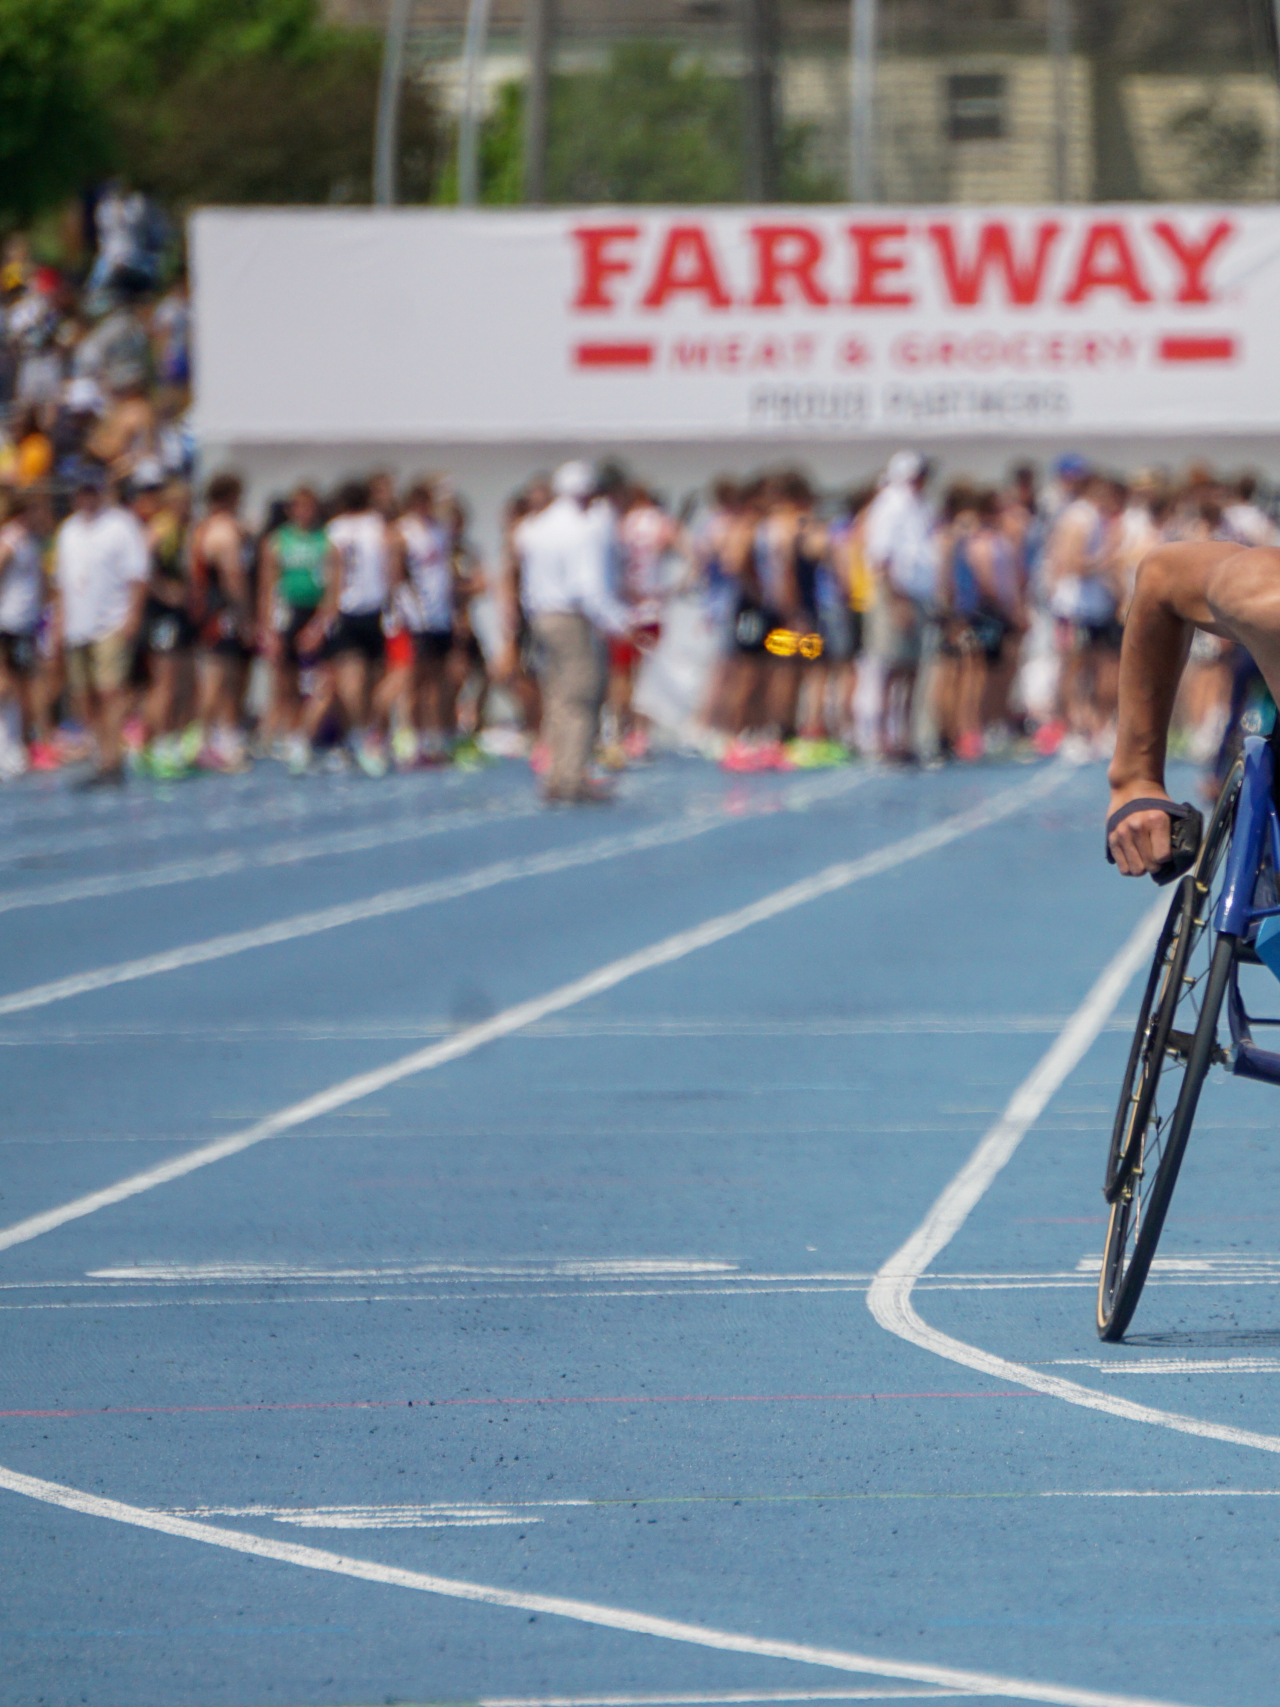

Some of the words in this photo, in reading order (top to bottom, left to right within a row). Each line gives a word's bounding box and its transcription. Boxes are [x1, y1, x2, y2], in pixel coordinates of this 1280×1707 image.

[571, 219, 1235, 312] FAREWAY
[673, 334, 817, 373] MEAT
[892, 331, 1138, 372] GROCERY
